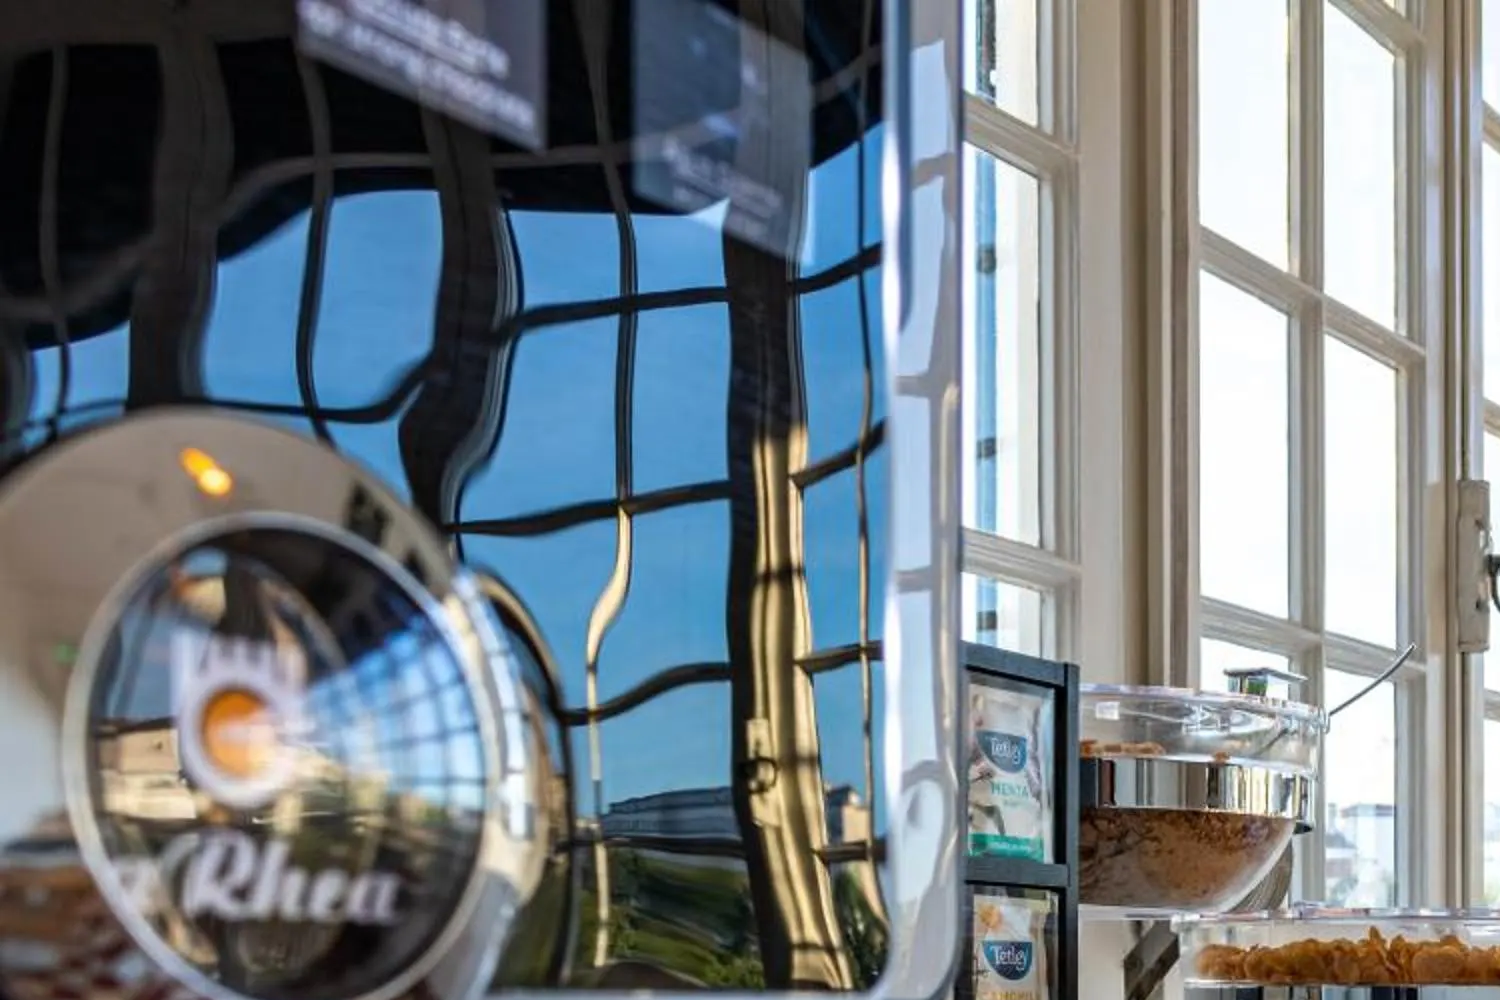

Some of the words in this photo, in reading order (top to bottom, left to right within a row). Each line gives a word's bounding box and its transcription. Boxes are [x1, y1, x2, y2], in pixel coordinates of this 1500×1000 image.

[987, 737, 1022, 765] Tetley
[162, 828, 400, 923] Rhea
[988, 944, 1029, 972] Tetley
